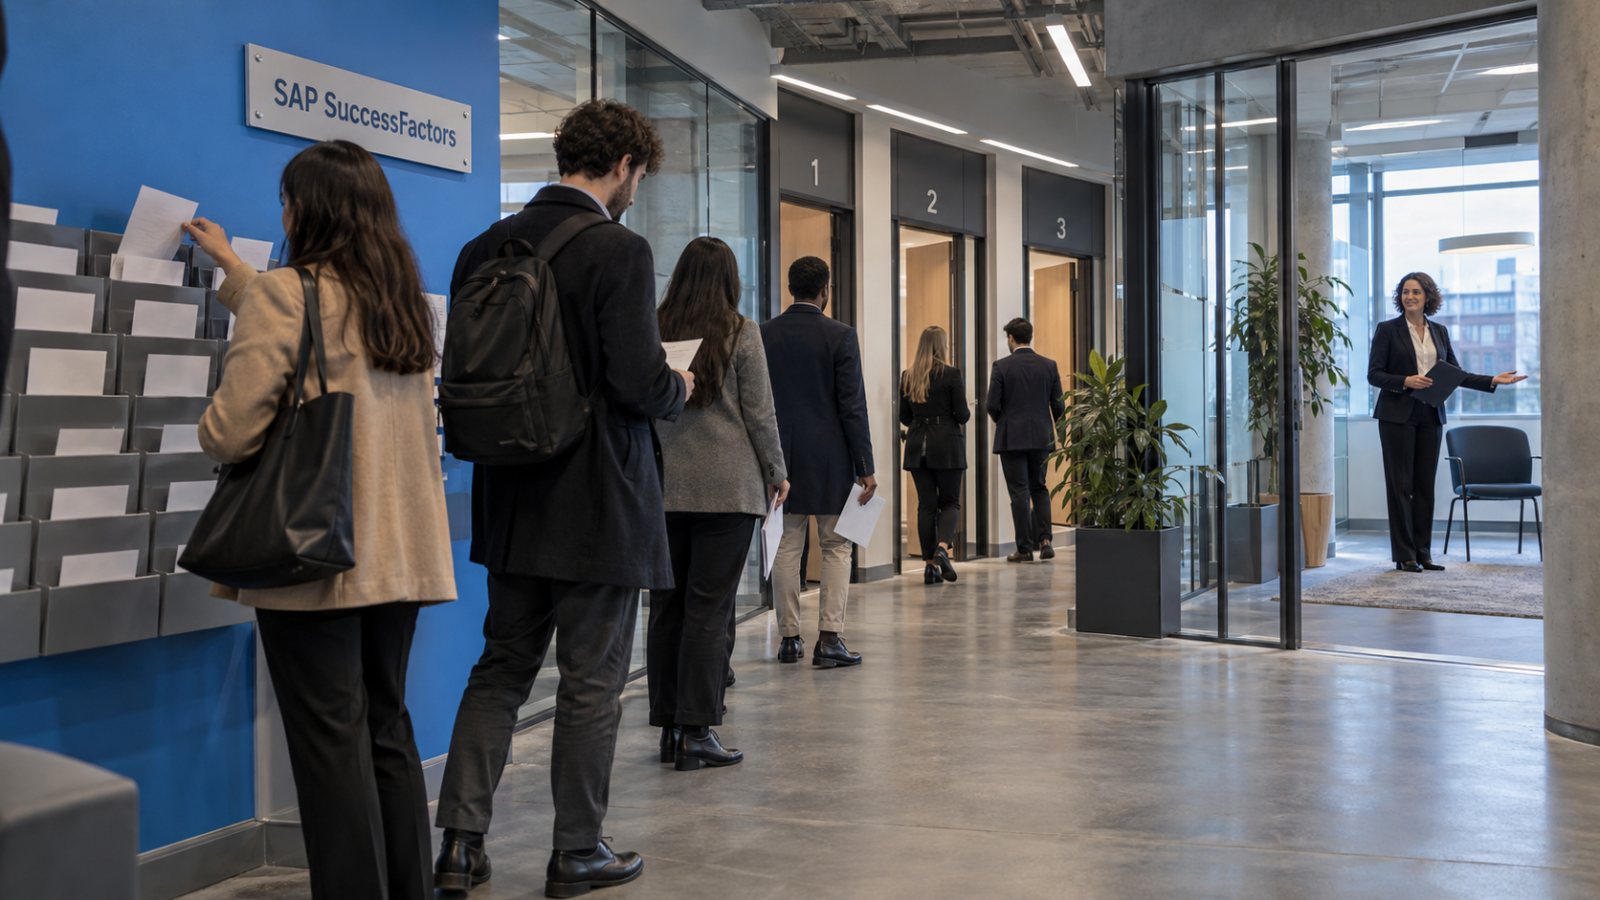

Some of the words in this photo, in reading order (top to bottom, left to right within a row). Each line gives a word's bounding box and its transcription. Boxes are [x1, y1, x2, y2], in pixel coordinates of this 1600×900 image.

[274, 78, 318, 112] SAP
[324, 91, 456, 147] SuccessFactors
[811, 158, 819, 186] 1
[927, 189, 938, 214] 2
[1056, 217, 1067, 240] 3
